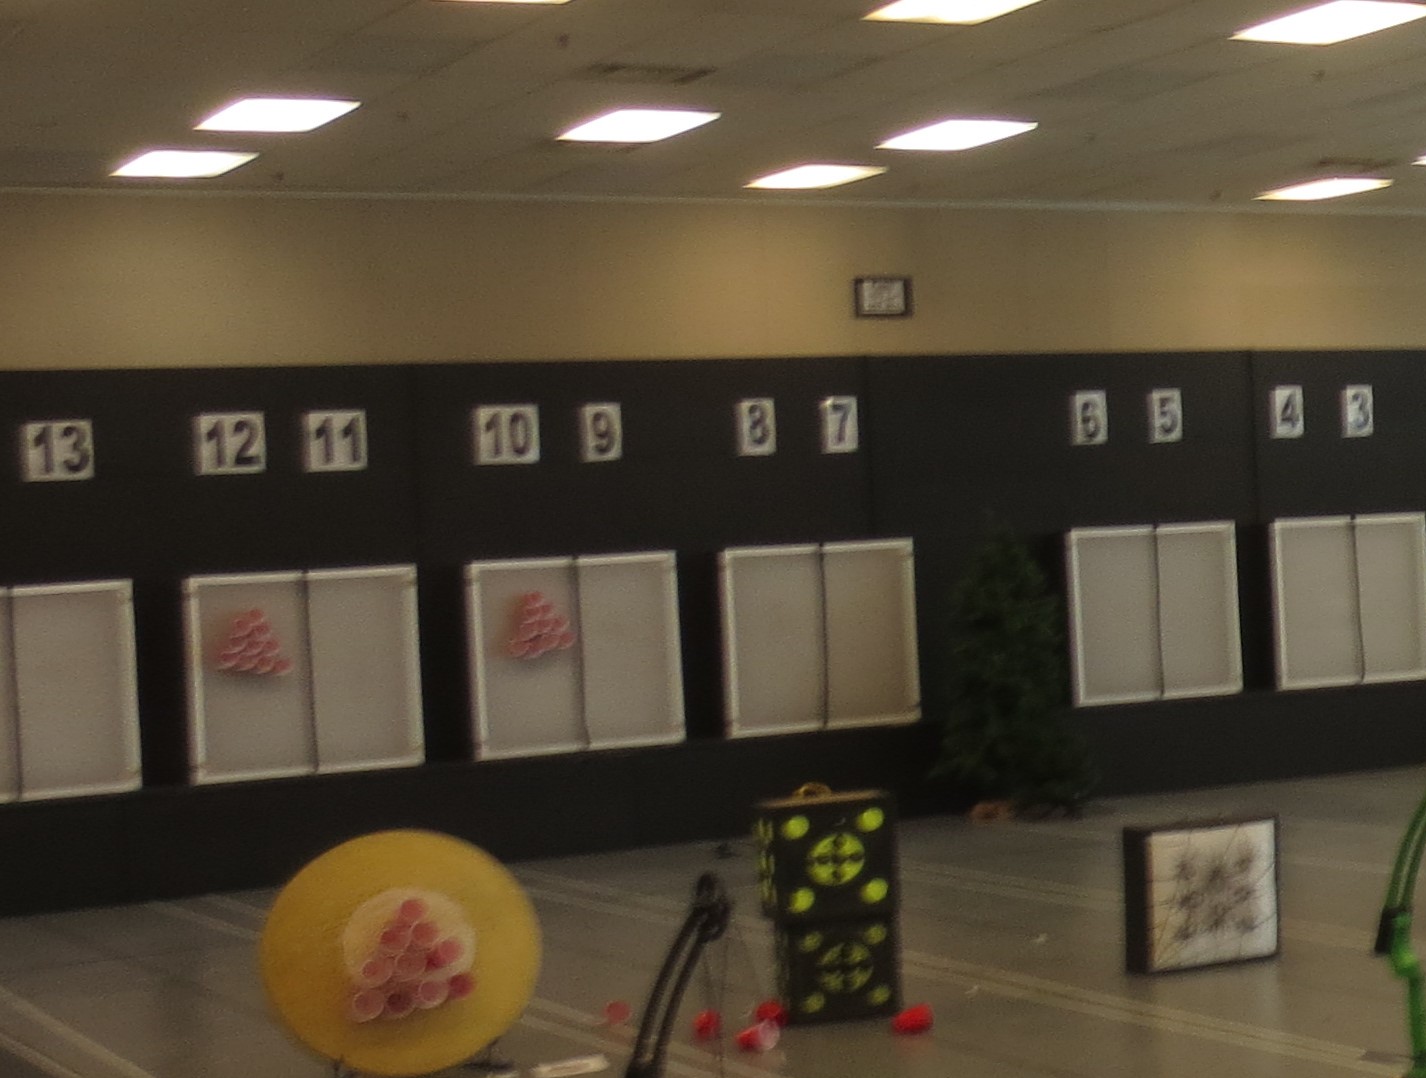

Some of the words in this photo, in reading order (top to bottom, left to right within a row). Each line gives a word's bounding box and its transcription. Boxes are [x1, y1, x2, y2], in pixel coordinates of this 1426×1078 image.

[748, 403, 771, 446] 8
[829, 402, 854, 445] 7
[1081, 401, 1098, 438] 6
[1159, 397, 1179, 434] 5
[1280, 391, 1299, 428] 4
[1352, 391, 1371, 430] 3
[34, 425, 91, 475] 13
[206, 419, 262, 469] 12
[315, 415, 363, 465] 11
[484, 411, 534, 458] 10
[591, 411, 617, 455] 9
